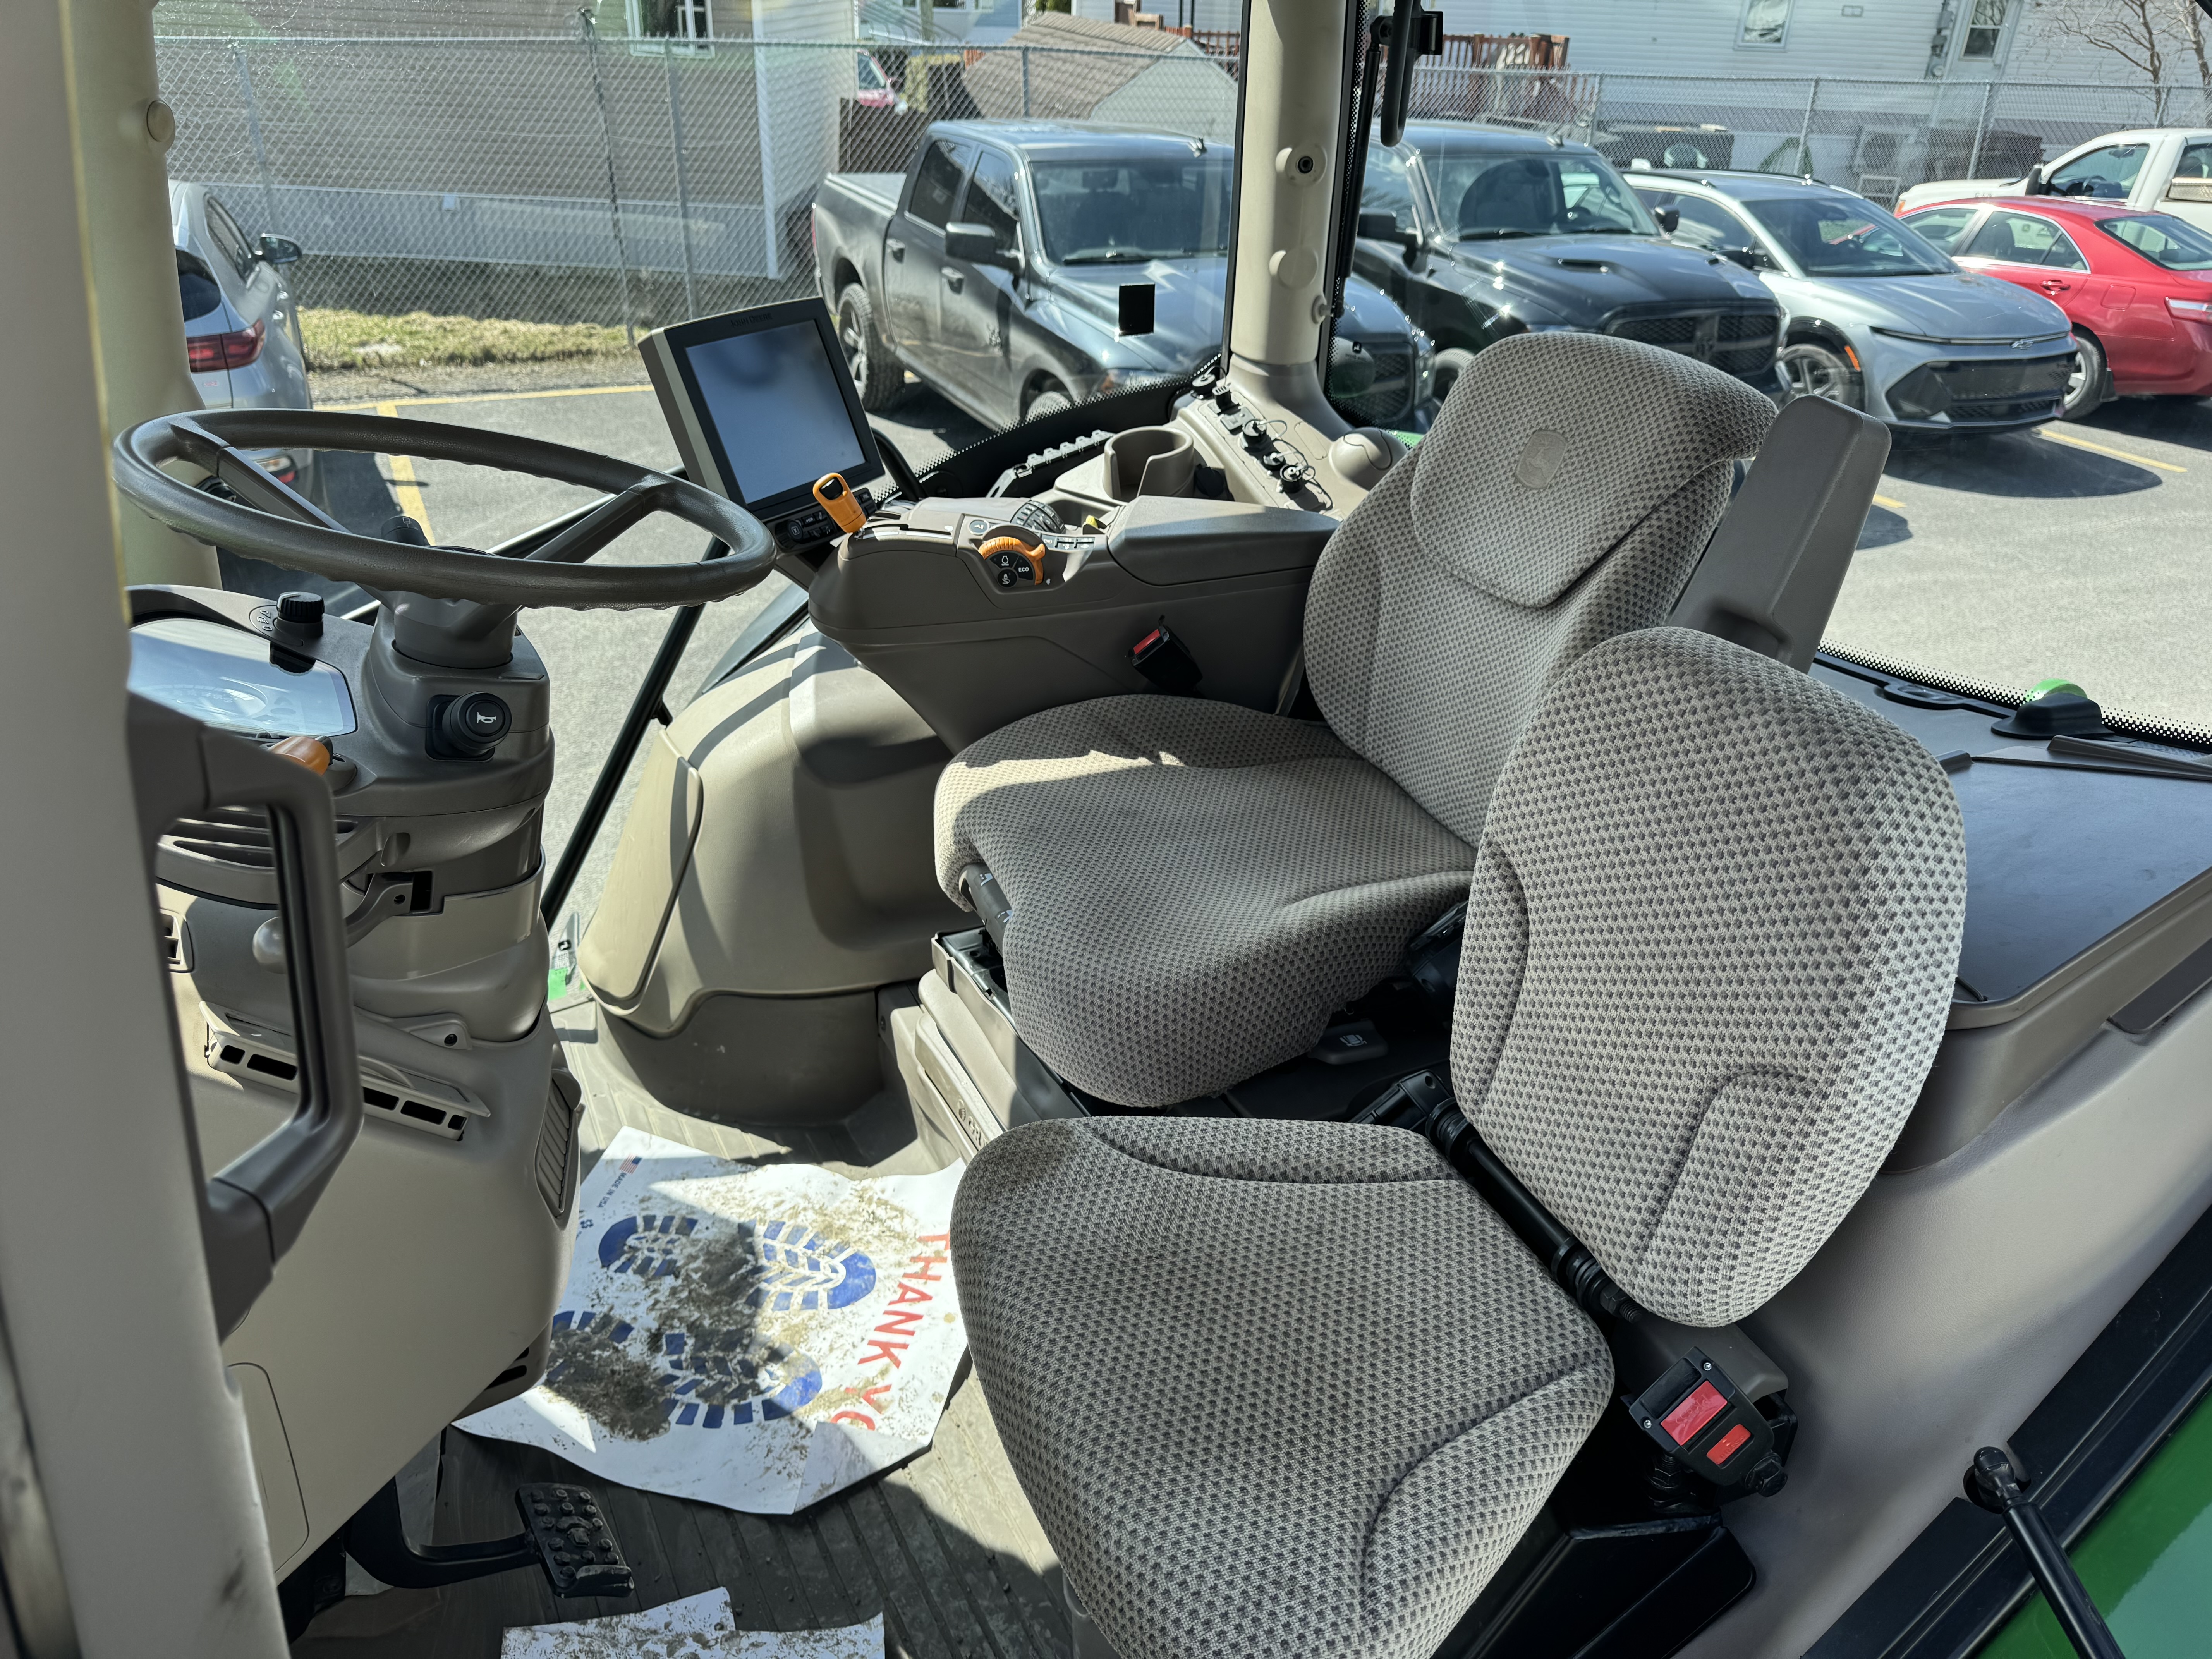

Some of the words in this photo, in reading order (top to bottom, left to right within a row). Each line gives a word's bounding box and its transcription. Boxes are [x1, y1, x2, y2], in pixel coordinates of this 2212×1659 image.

[611, 1171, 627, 1189] MADE
[606, 1188, 615, 1196] IN
[596, 1196, 610, 1208] USA
[857, 1229, 950, 1369] THANK
[1675, 1395, 1710, 1427] PRESS
